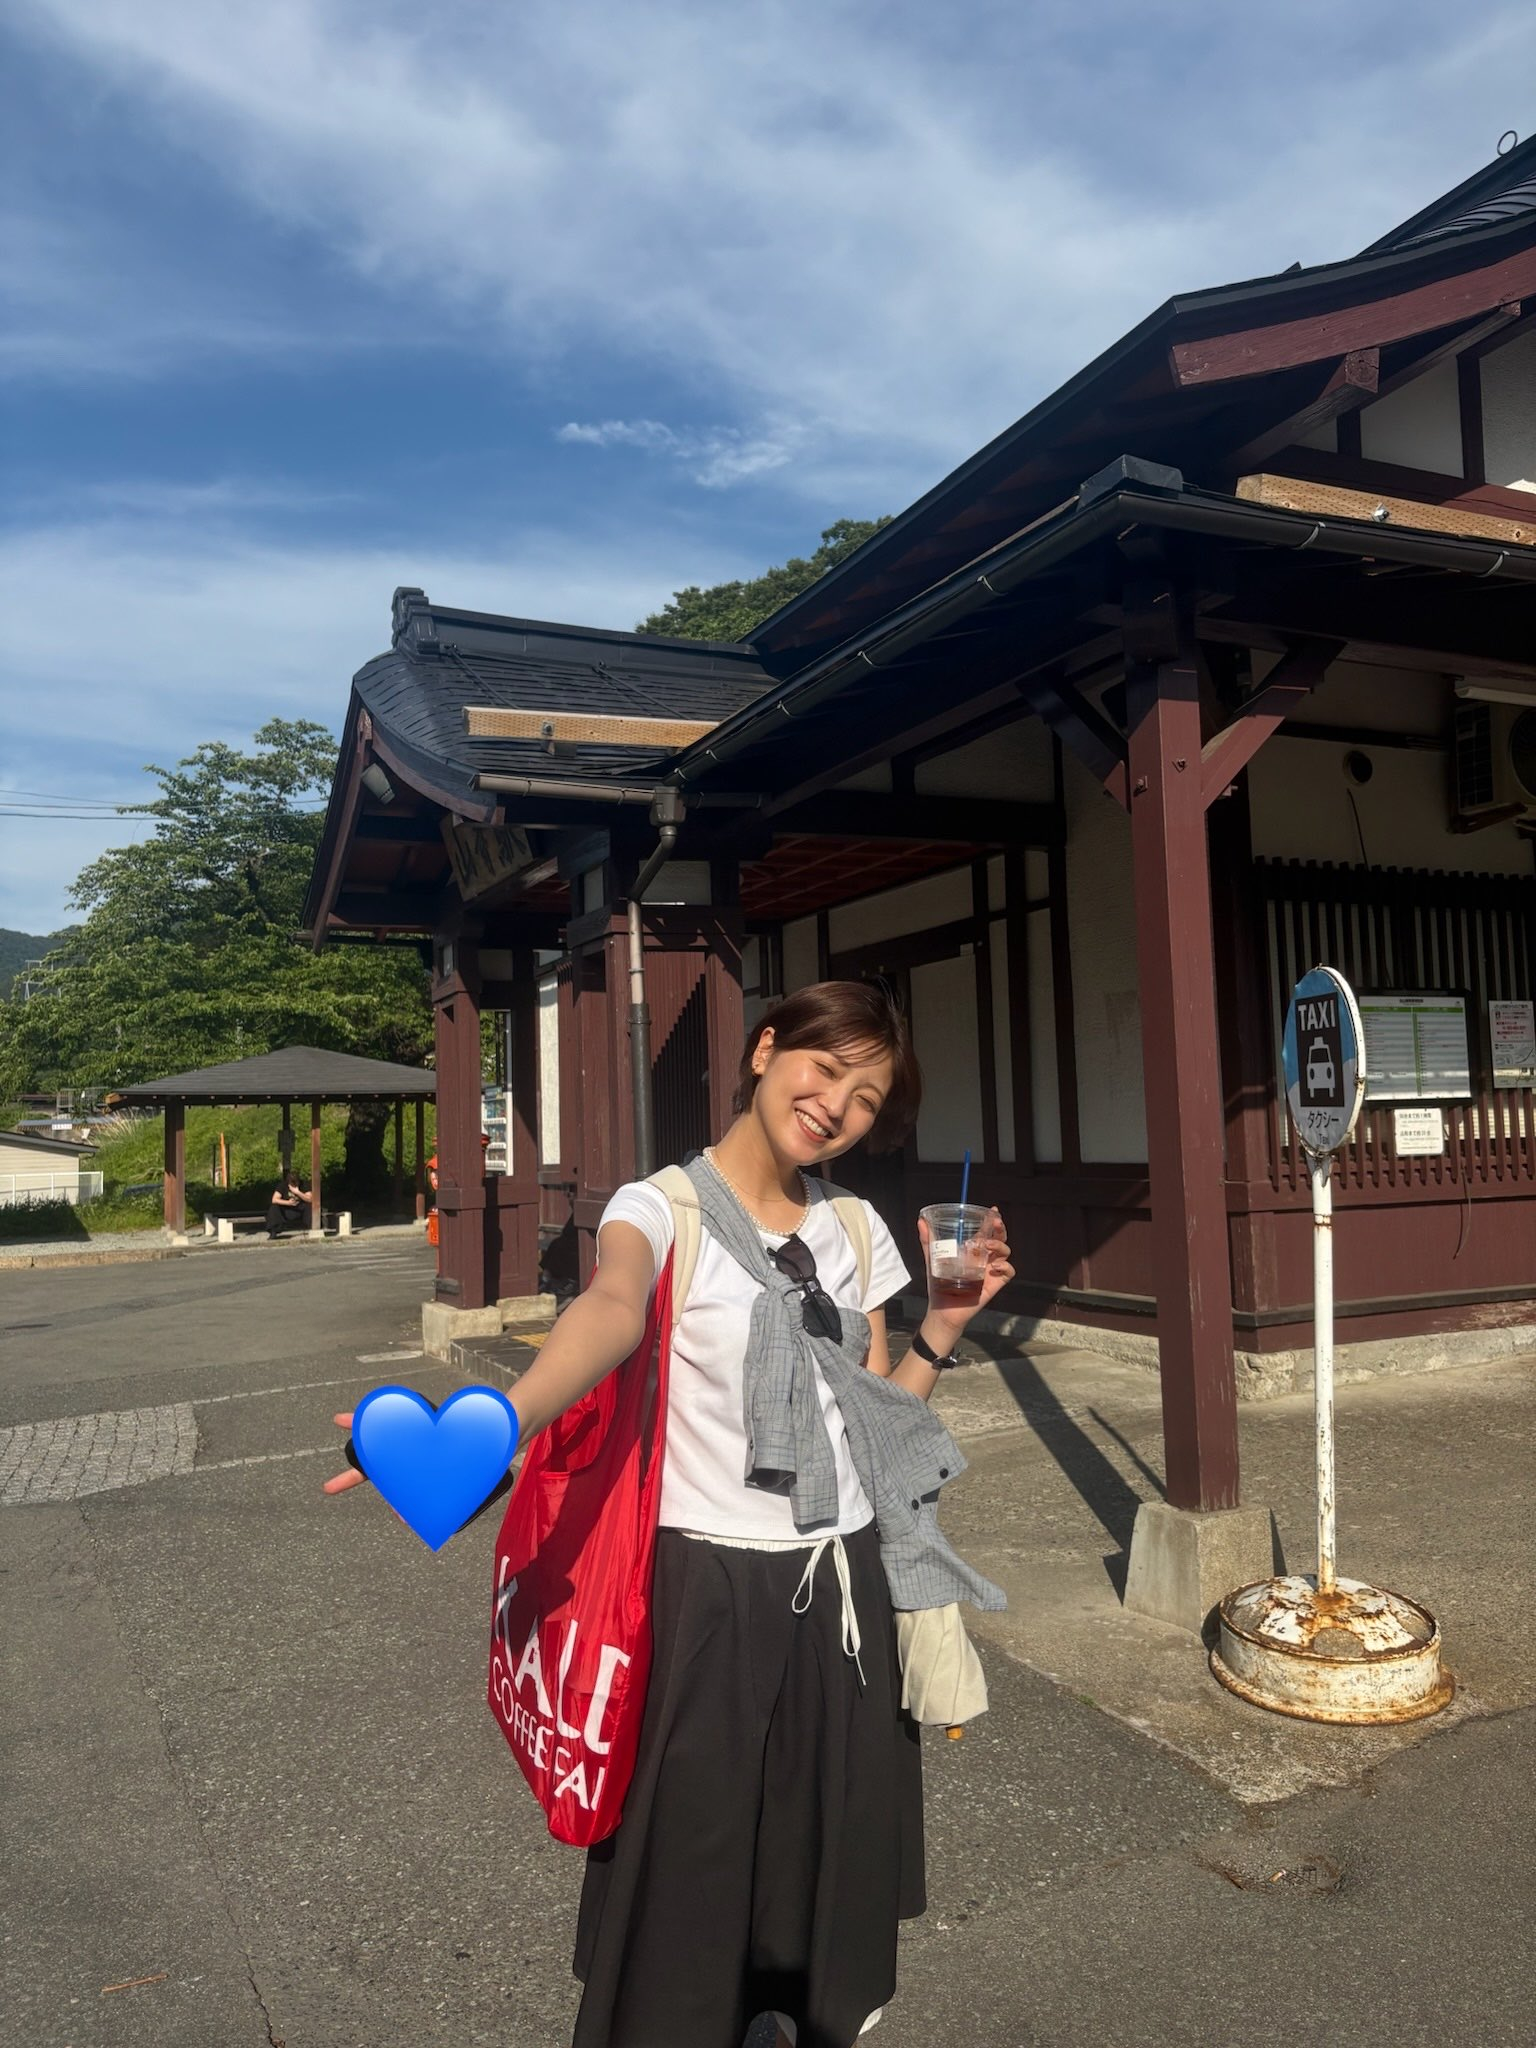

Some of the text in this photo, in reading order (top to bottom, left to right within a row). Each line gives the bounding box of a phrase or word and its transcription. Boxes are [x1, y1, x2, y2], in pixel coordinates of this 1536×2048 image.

[1298, 1000, 1336, 1031] TAXI
[1307, 1110, 1340, 1129] タクシー
[493, 1656, 554, 1771] COFFEE
